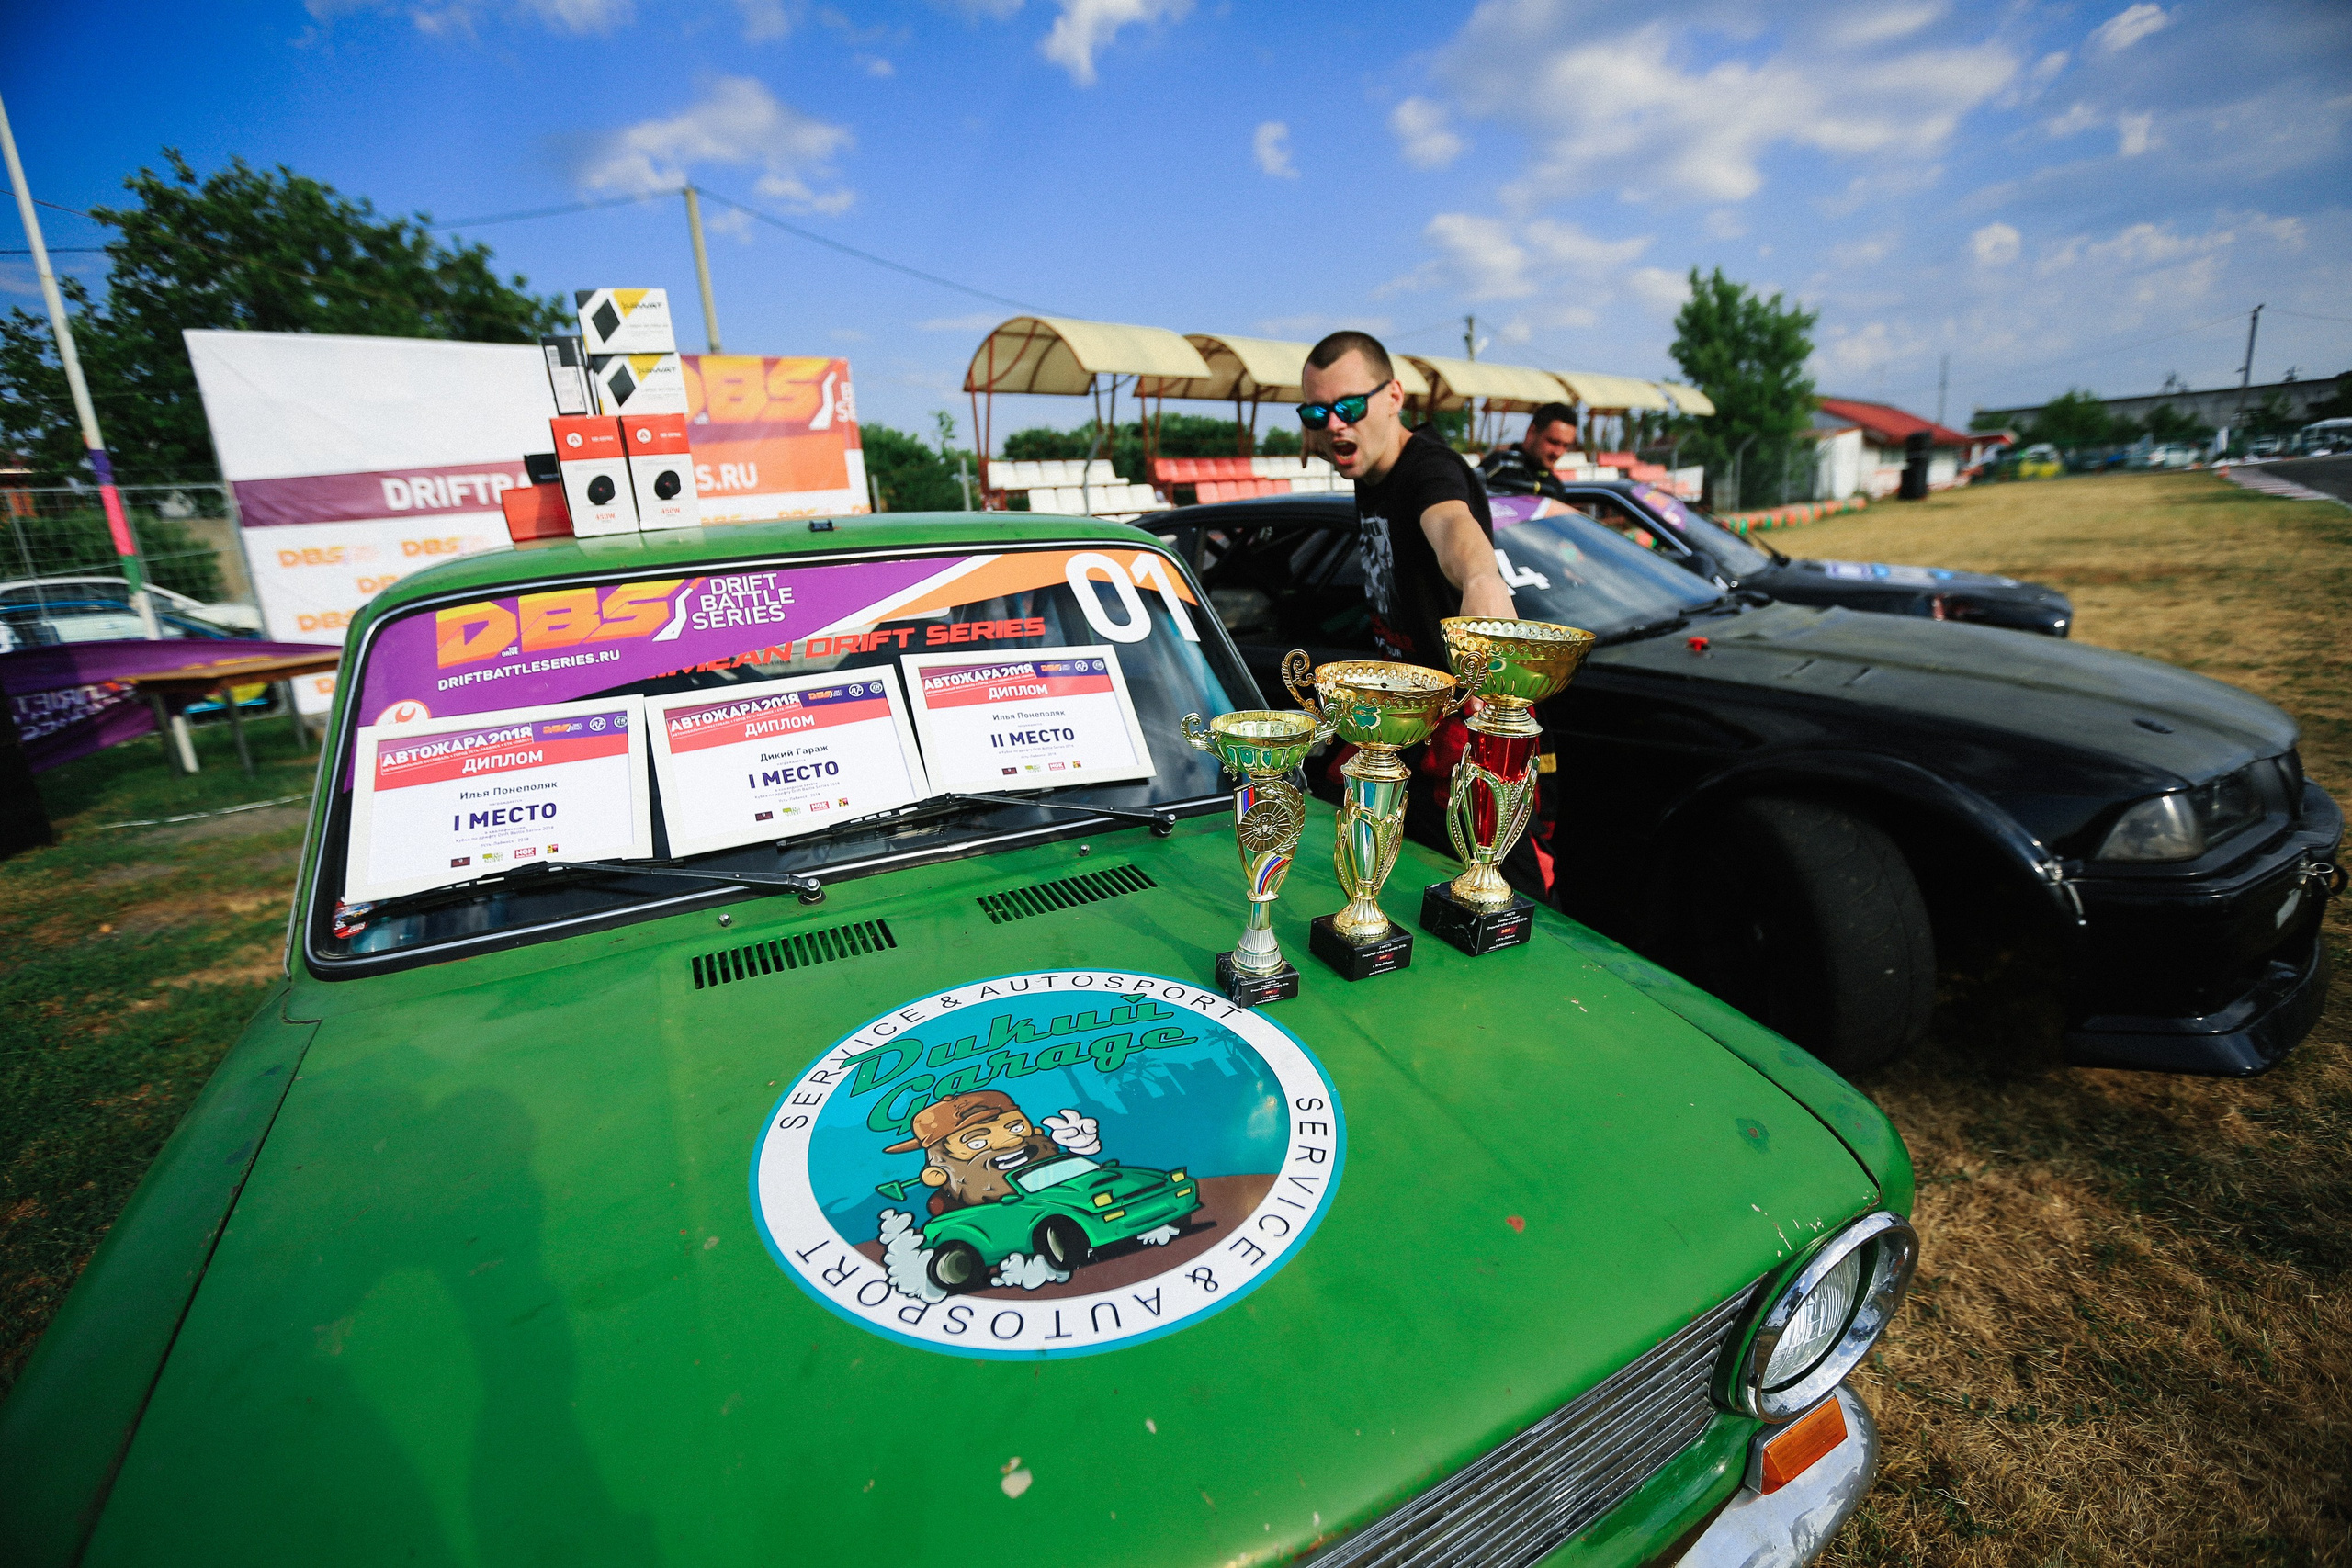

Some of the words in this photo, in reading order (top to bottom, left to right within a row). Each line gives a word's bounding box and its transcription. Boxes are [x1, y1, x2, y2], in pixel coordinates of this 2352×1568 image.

[708, 573, 778, 596] DRIFT
[1064, 551, 1201, 644] 01
[700, 585, 796, 614] BATTLE
[435, 579, 685, 670] DBS
[691, 604, 786, 630] SERIES
[805, 627, 916, 660] DRIFT
[926, 617, 1046, 647] SERIES
[437, 649, 620, 691] DRIFTBATTLESERIES.RU
[989, 684, 1048, 700] ДИПЛОМ
[744, 714, 815, 738] ДИПЛОМ
[1017, 710, 1065, 719] Понеполяк
[1009, 728, 1075, 746] МЕСТО
[461, 750, 543, 774] ДИПЛОМ
[760, 749, 794, 762] Дикий
[796, 745, 829, 756] Гараж
[762, 761, 839, 786] МЕСТО
[460, 790, 489, 800] Илья
[492, 781, 558, 796] Понеполяк
[469, 802, 557, 829] МЕСТО
[778, 1004, 927, 1131] SERVICE
[940, 995, 962, 1010] &
[978, 974, 1244, 1020] AUTOSPORT
[1231, 1096, 1329, 1268] SERVICE
[793, 1238, 1163, 1341] AUTOSPORT
[1184, 1265, 1220, 1293] &
